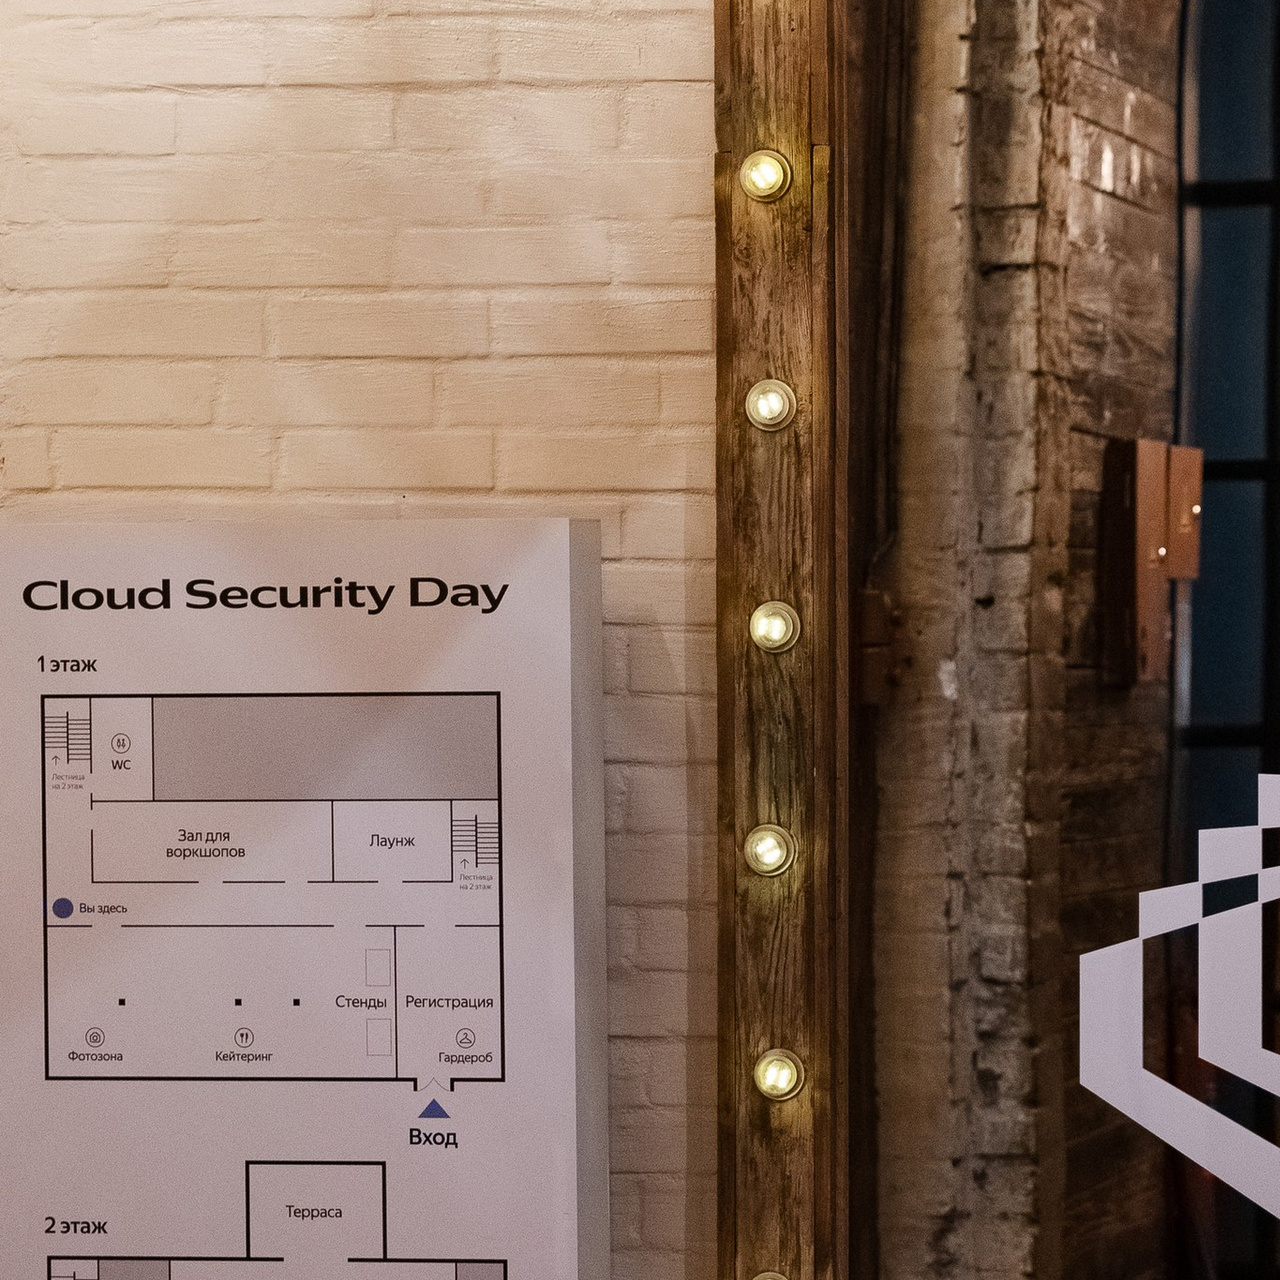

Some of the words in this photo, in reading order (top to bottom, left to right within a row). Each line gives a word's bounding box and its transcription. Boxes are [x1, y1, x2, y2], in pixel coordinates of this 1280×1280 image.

[22, 578, 171, 611] Cloud
[185, 576, 395, 616] Security
[409, 577, 509, 614] Day
[37, 655, 45, 673] 1
[50, 659, 97, 673] этаж
[111, 759, 131, 771] WC
[178, 828, 203, 843] Зал
[204, 831, 231, 844] для
[369, 833, 415, 850] Лаунж
[165, 847, 246, 860] воркшопов
[459, 873, 494, 882] Лестница
[79, 902, 96, 914] Вы
[97, 904, 128, 915] здесь
[335, 994, 388, 1010] Стенды
[405, 994, 494, 1010] Регистрация
[67, 1050, 124, 1062] Фотозона
[215, 1051, 273, 1064] Кейтеринг
[438, 1051, 493, 1065] Гардероб
[409, 1127, 459, 1149] Вход
[285, 1204, 343, 1221] Терраса
[44, 1216, 56, 1234] 2
[60, 1220, 108, 1234] этаж
